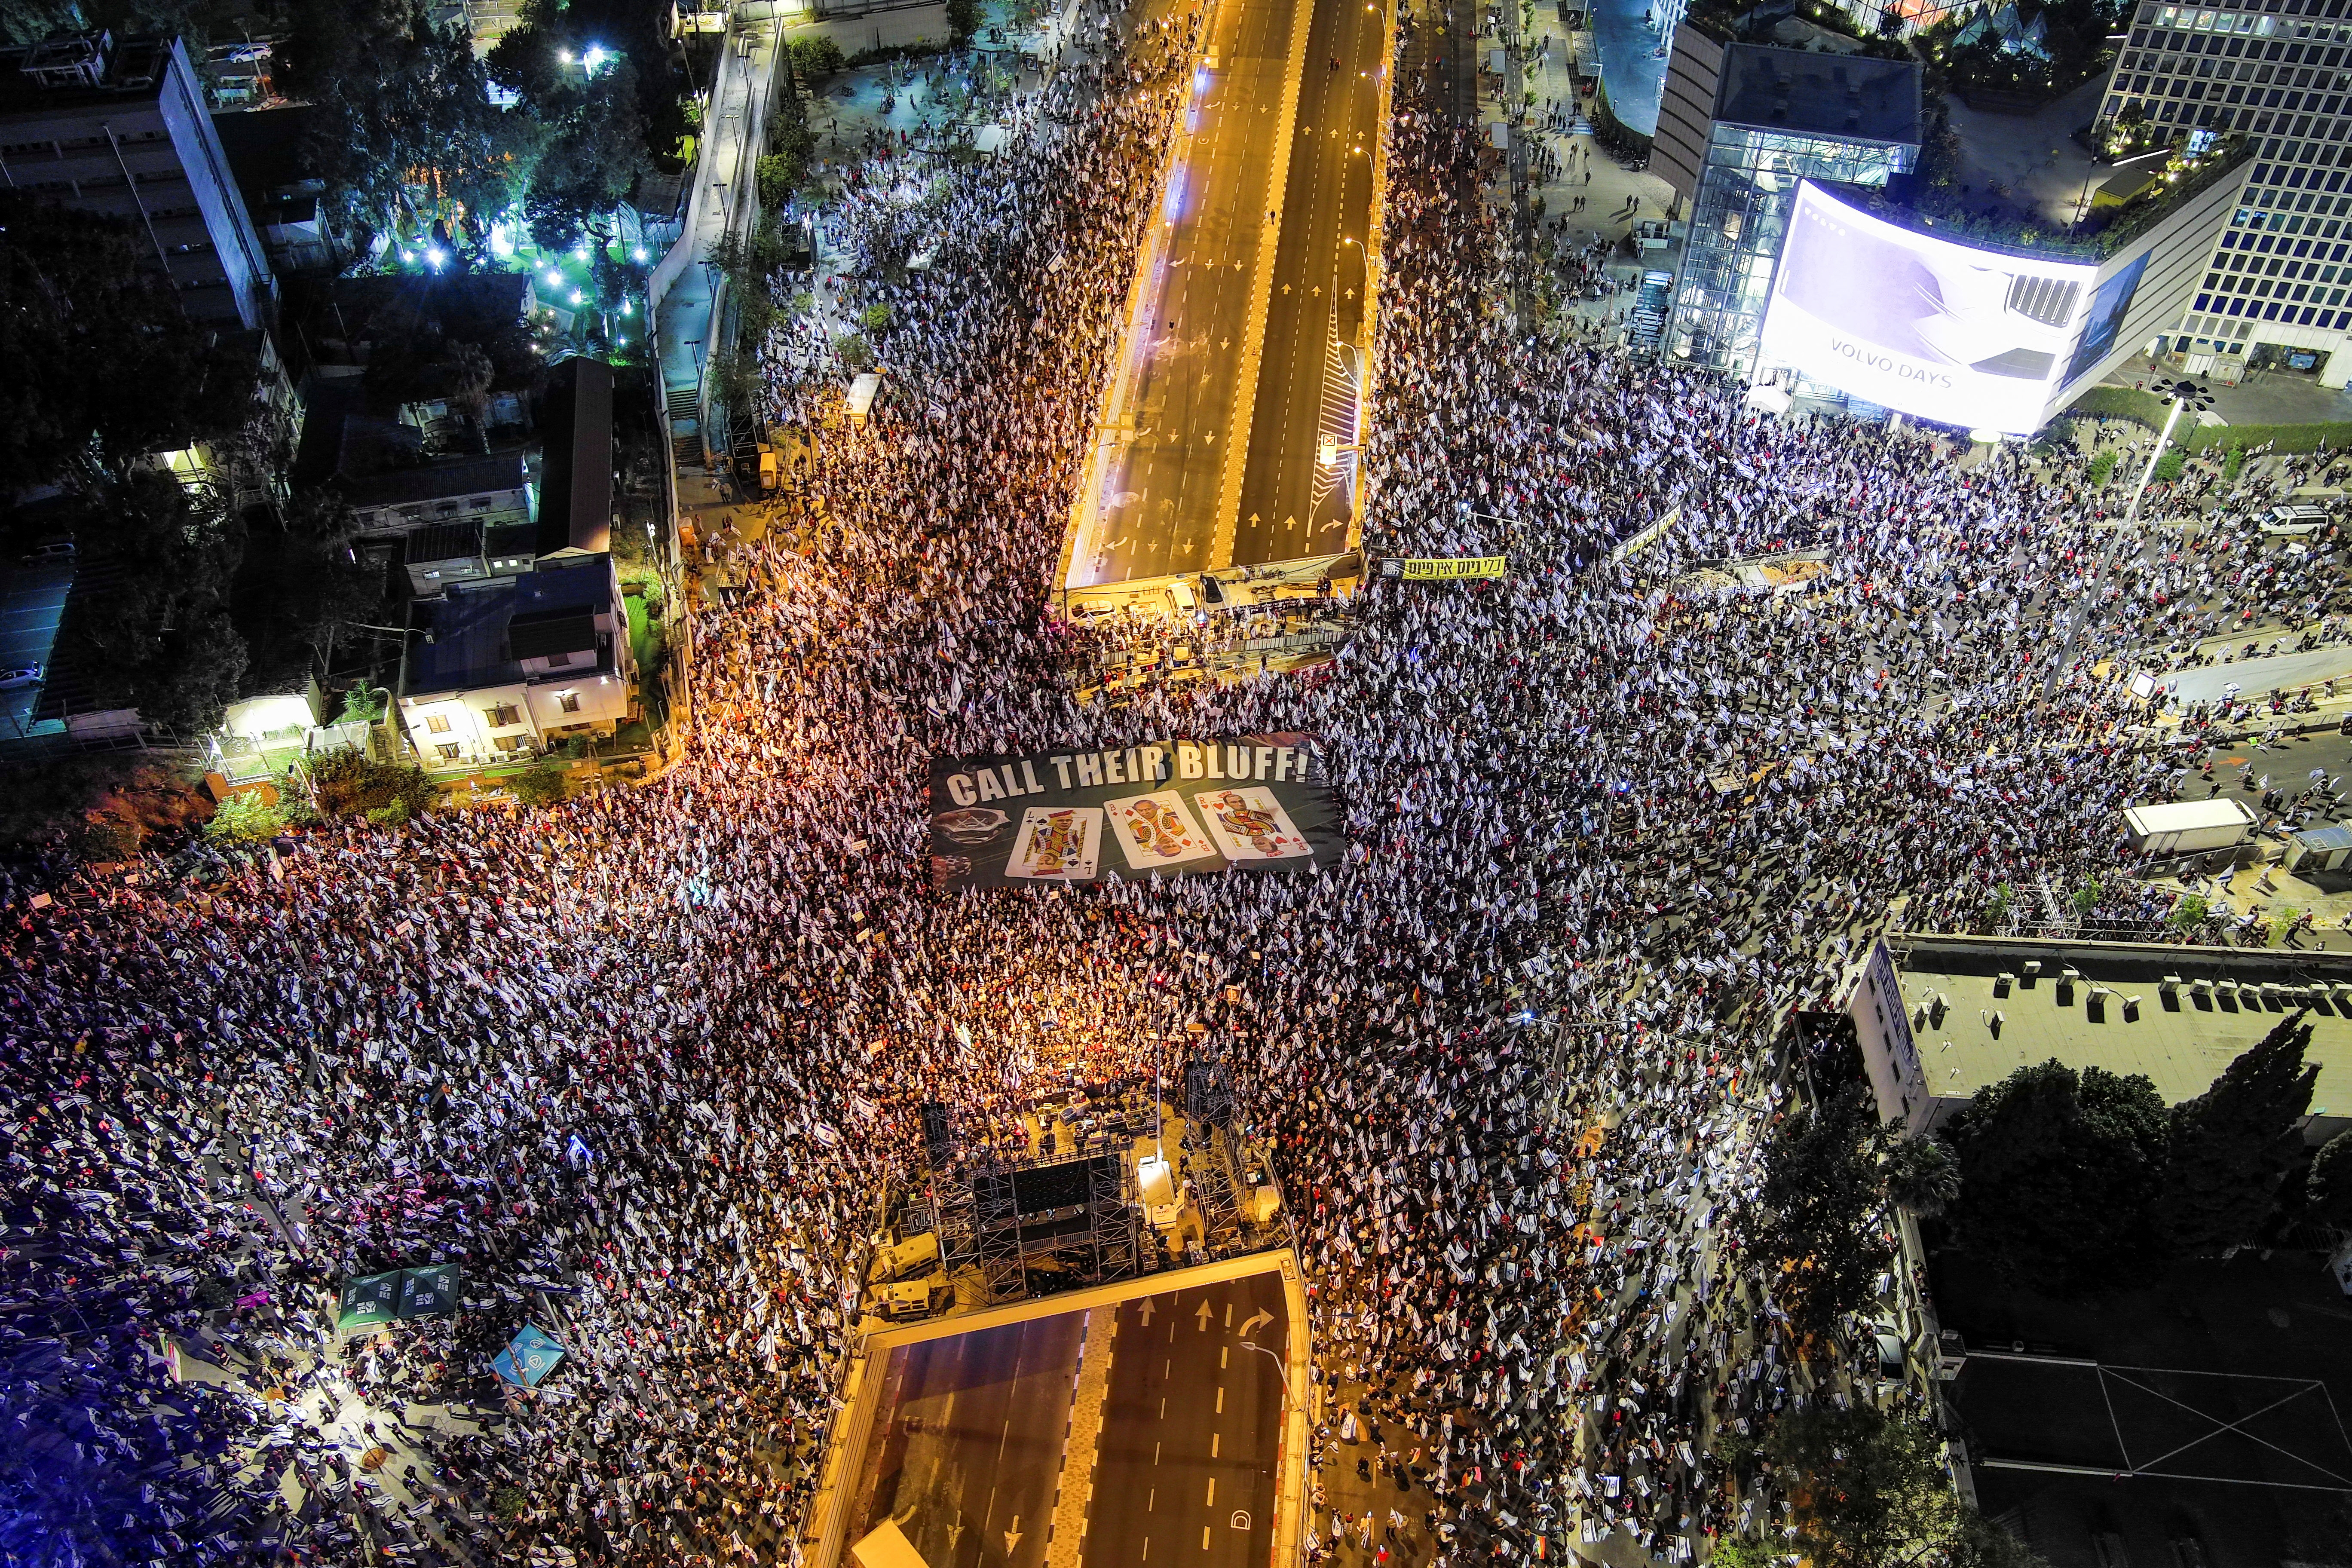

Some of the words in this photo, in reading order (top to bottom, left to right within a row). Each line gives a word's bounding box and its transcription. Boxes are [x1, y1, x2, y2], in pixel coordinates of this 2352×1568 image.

[1832, 337, 1893, 372] VOLVO
[1899, 364, 1953, 389] DAYS
[1409, 561, 1434, 576] פיוס
[1436, 562, 1453, 576] אין
[1457, 560, 1481, 574] גיוס
[1484, 559, 1501, 572] בלי
[947, 758, 1045, 806] CALL
[1050, 746, 1167, 789] THEIR
[1179, 745, 1307, 783] BLUFF!
